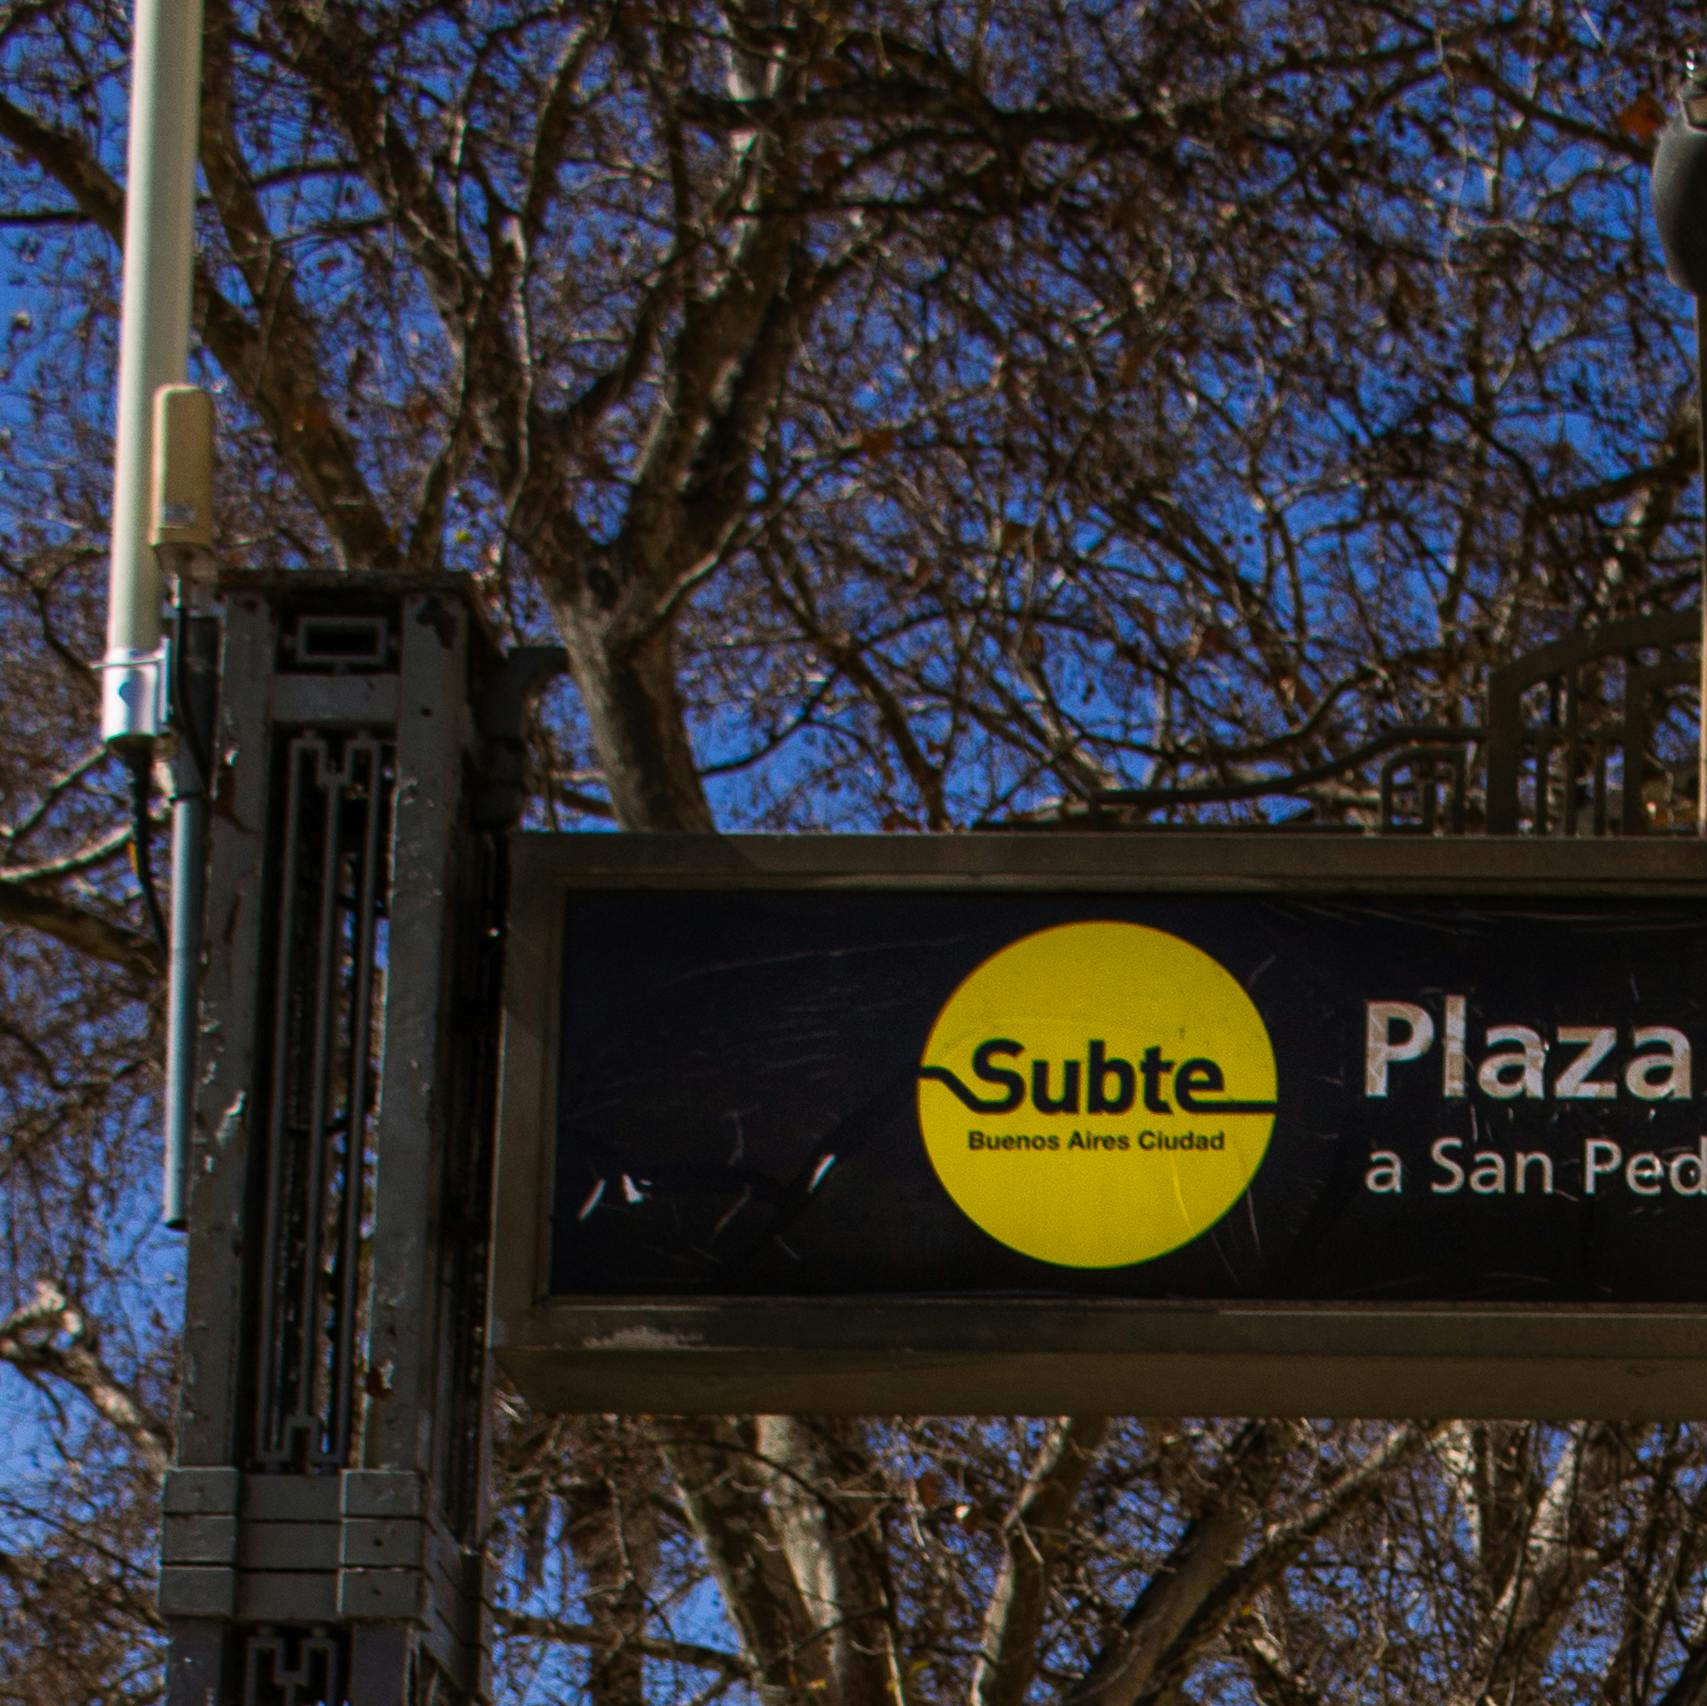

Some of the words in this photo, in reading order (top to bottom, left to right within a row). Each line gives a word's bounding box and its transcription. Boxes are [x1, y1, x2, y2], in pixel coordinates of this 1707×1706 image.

[958, 1038, 1240, 1116] Subte
[1365, 995, 1692, 1101] Plaza
[968, 1130, 1060, 1150] Buenos
[1067, 1130, 1130, 1150] Aires
[1138, 1130, 1225, 1150] Ciudad
[1365, 1150, 1401, 1194] a
[1430, 1136, 1553, 1194] San
